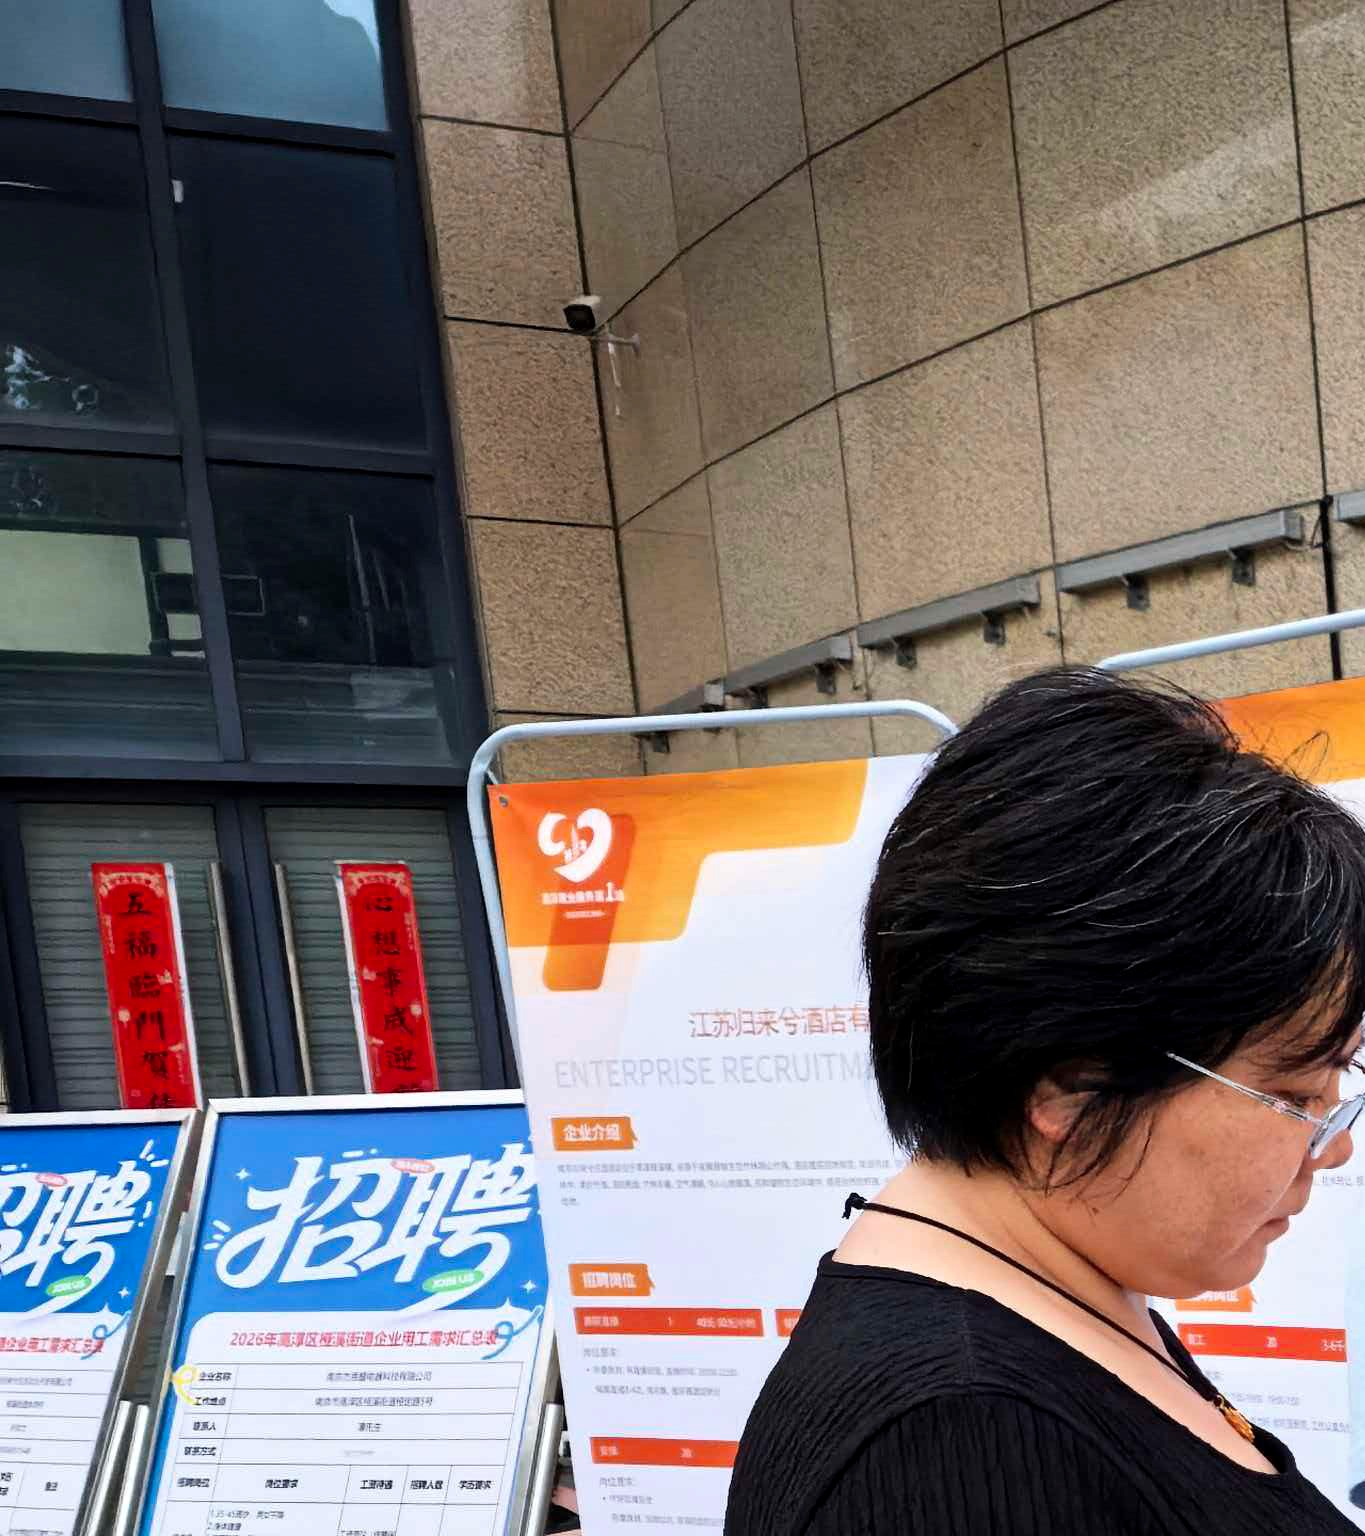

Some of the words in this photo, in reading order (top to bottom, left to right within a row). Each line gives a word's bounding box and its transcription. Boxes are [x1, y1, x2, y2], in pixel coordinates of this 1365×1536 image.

[554, 1052, 713, 1089] ENTERPRISE
[721, 1048, 872, 1083] RECRUITM
[563, 1124, 623, 1143] 企业介绍
[215, 1144, 541, 1313] 招聘
